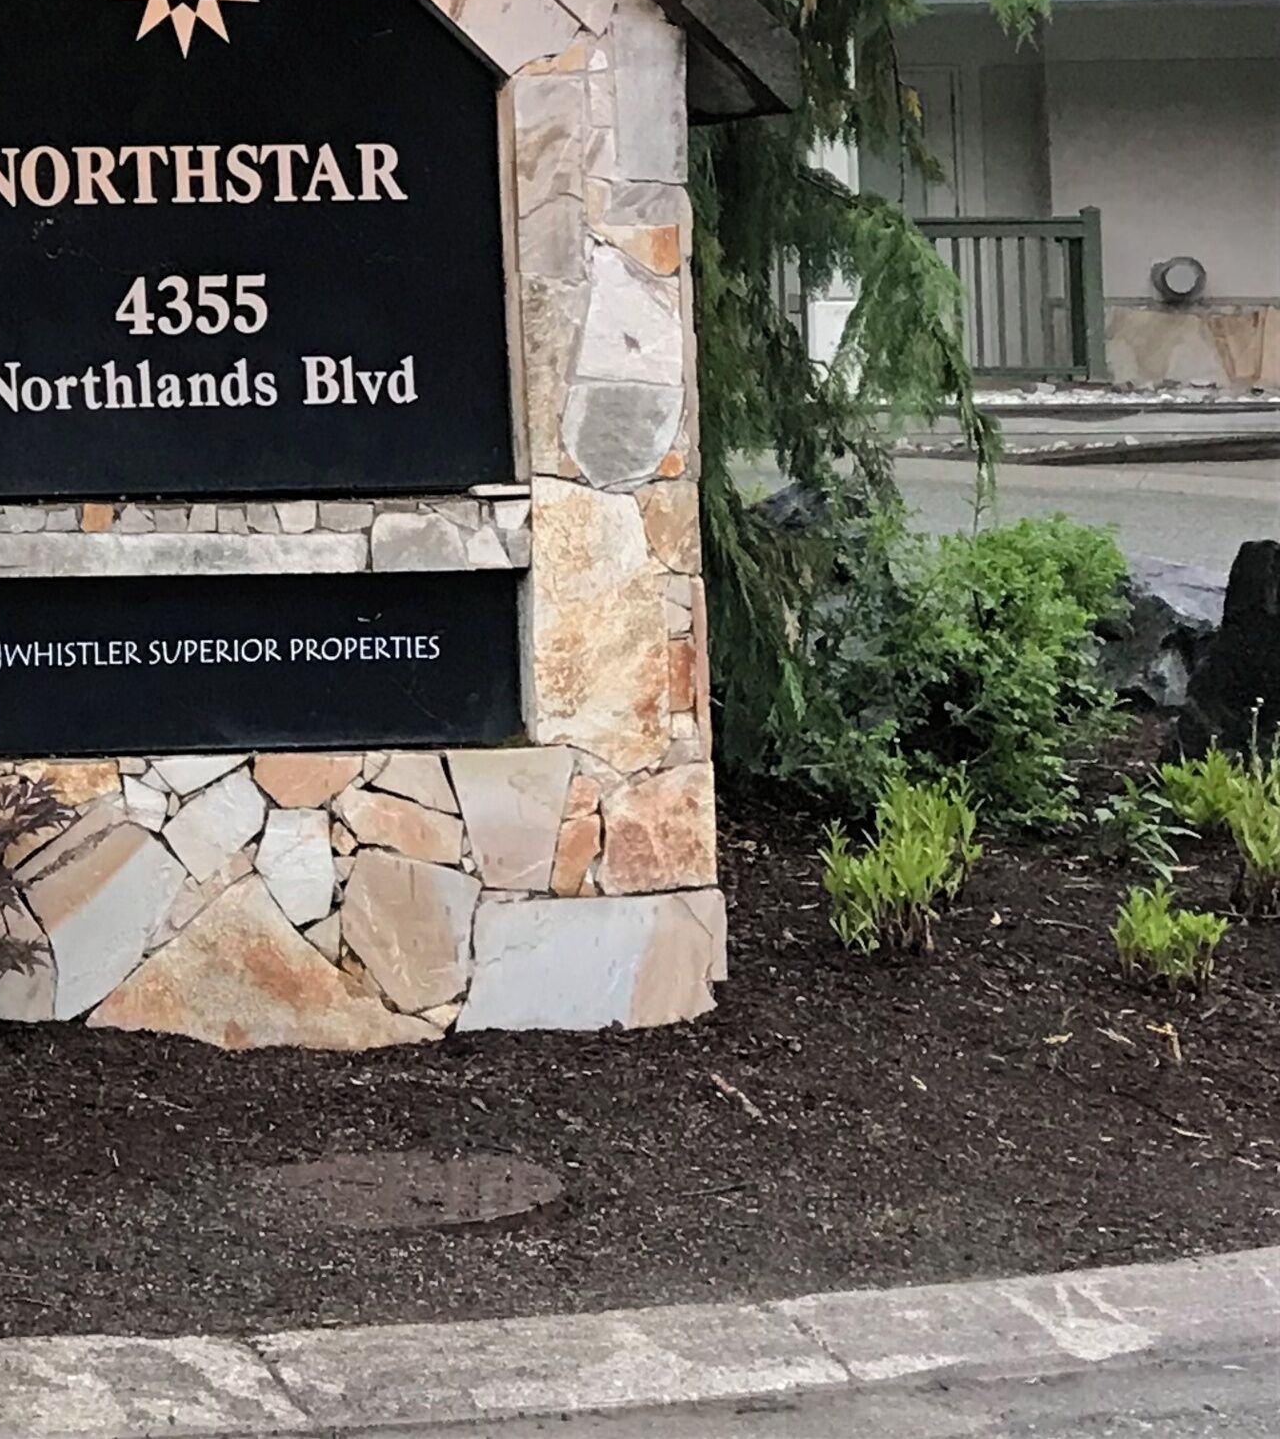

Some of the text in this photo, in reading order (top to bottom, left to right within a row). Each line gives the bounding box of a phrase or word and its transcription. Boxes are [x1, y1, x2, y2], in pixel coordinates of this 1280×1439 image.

[115, 274, 269, 335] 4355
[302, 356, 419, 405] Blvd
[5, 635, 440, 667] WHISTLER SUPERIOR PROPERTIES
